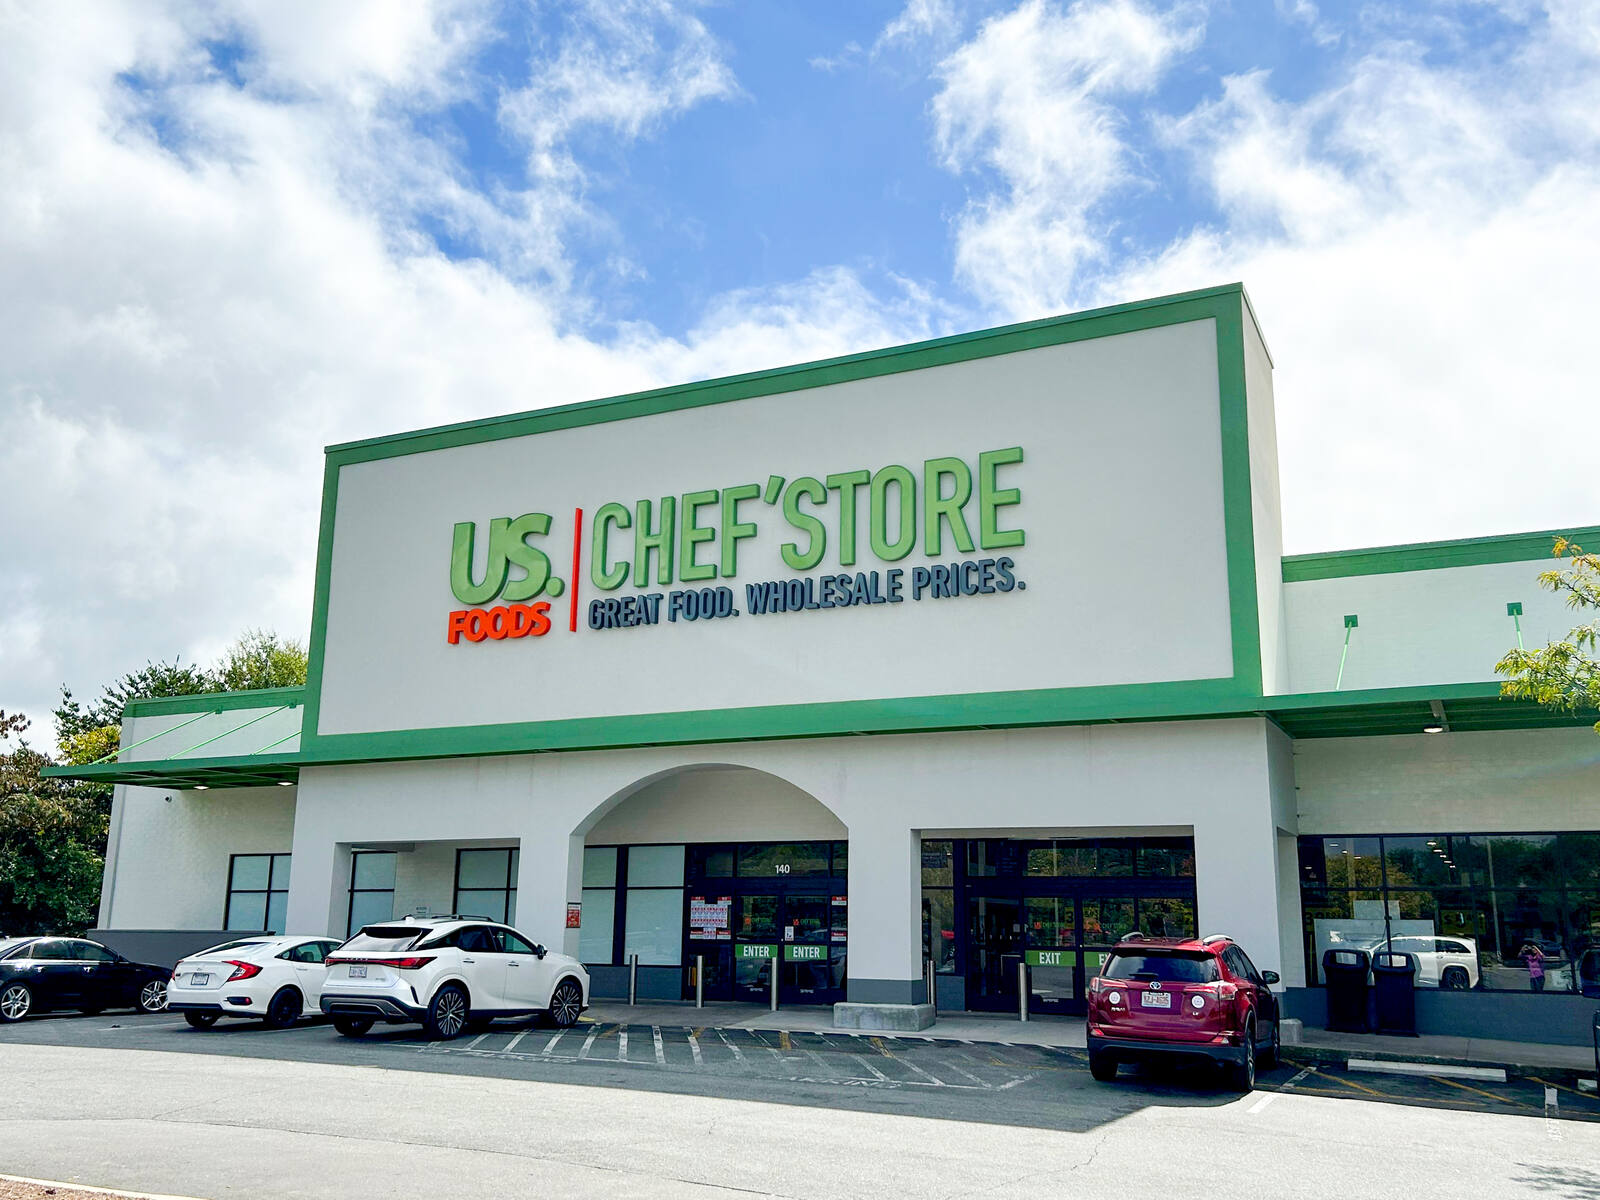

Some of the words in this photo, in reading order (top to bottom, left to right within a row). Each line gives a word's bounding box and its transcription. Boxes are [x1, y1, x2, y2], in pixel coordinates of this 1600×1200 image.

[591, 446, 1025, 591] CHEF'STORE
[588, 593, 664, 630] GREAT
[667, 586, 740, 623] FOOD.
[745, 568, 904, 616] WHOLESALE
[912, 556, 1027, 601] PRICES.
[447, 601, 552, 645] FOODS
[775, 864, 791, 874] 140
[743, 945, 770, 958] ENTER
[793, 947, 820, 958] ENTER
[1039, 952, 1061, 964] EXIT
